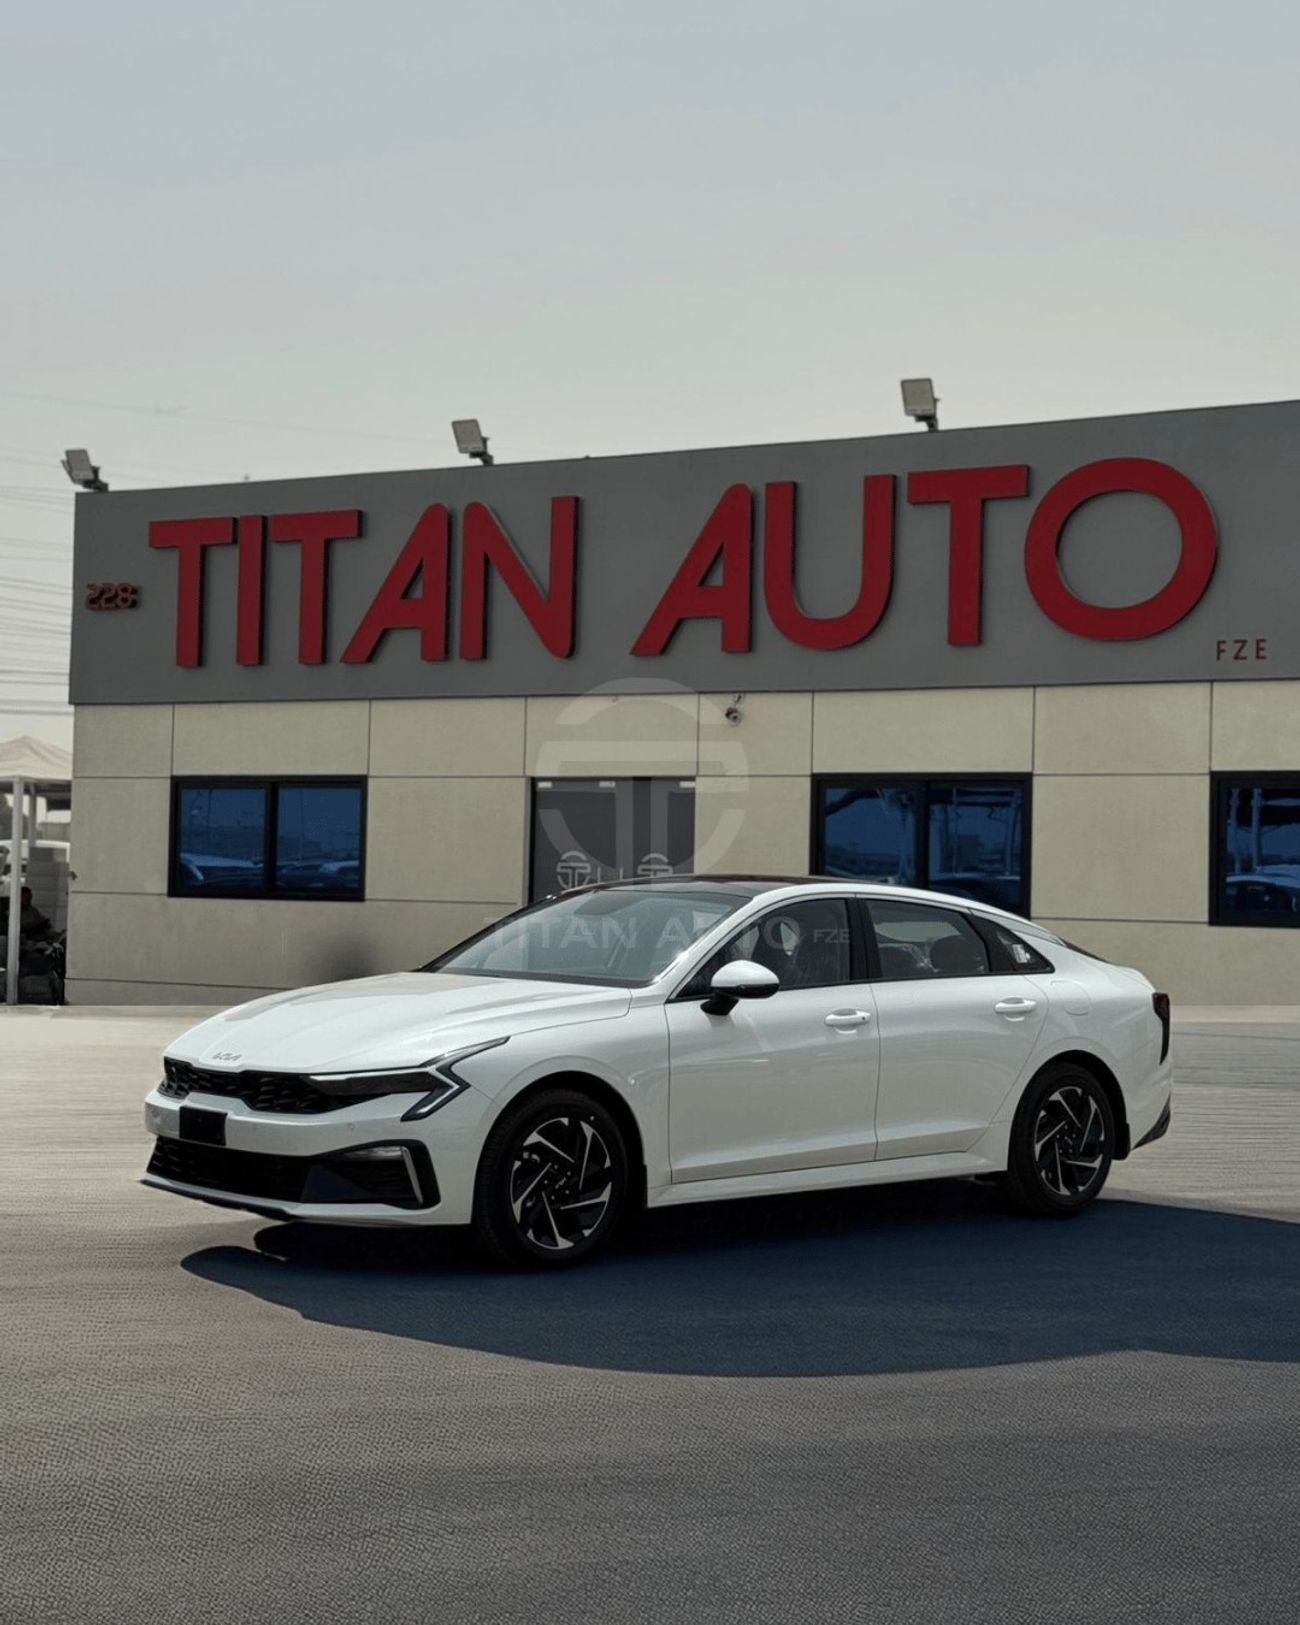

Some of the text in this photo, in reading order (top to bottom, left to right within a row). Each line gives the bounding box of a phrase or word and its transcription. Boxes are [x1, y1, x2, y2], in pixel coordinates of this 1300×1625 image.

[148, 457, 1219, 669] TITAN AUTO
[85, 583, 134, 610] 228
[1216, 638, 1267, 661] FZE
